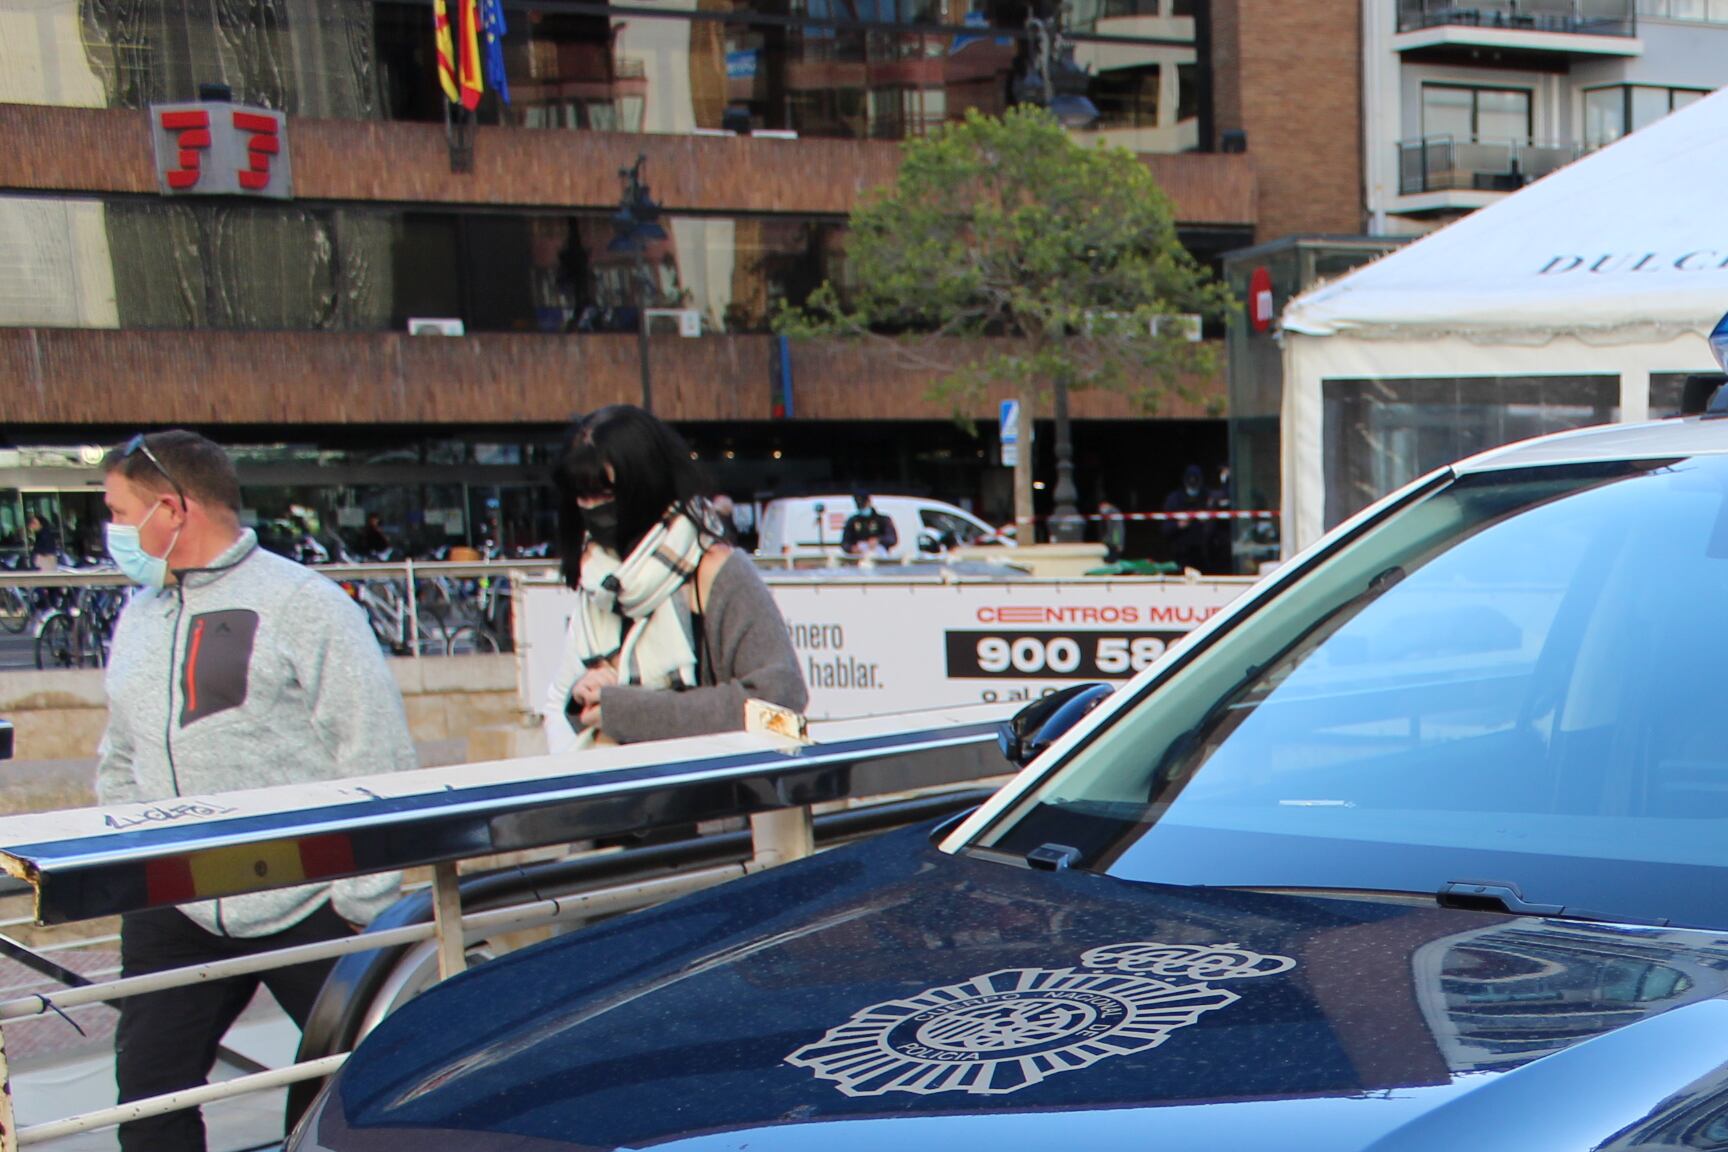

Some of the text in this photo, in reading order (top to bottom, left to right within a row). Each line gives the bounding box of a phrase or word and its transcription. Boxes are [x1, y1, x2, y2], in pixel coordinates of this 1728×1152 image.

[976, 606, 1138, 623] CENTROS
[808, 655, 885, 690] hablar.
[976, 636, 1182, 674] 900 58
[896, 991, 1123, 1062] CUERPO NACIONAL DE POLICIA
